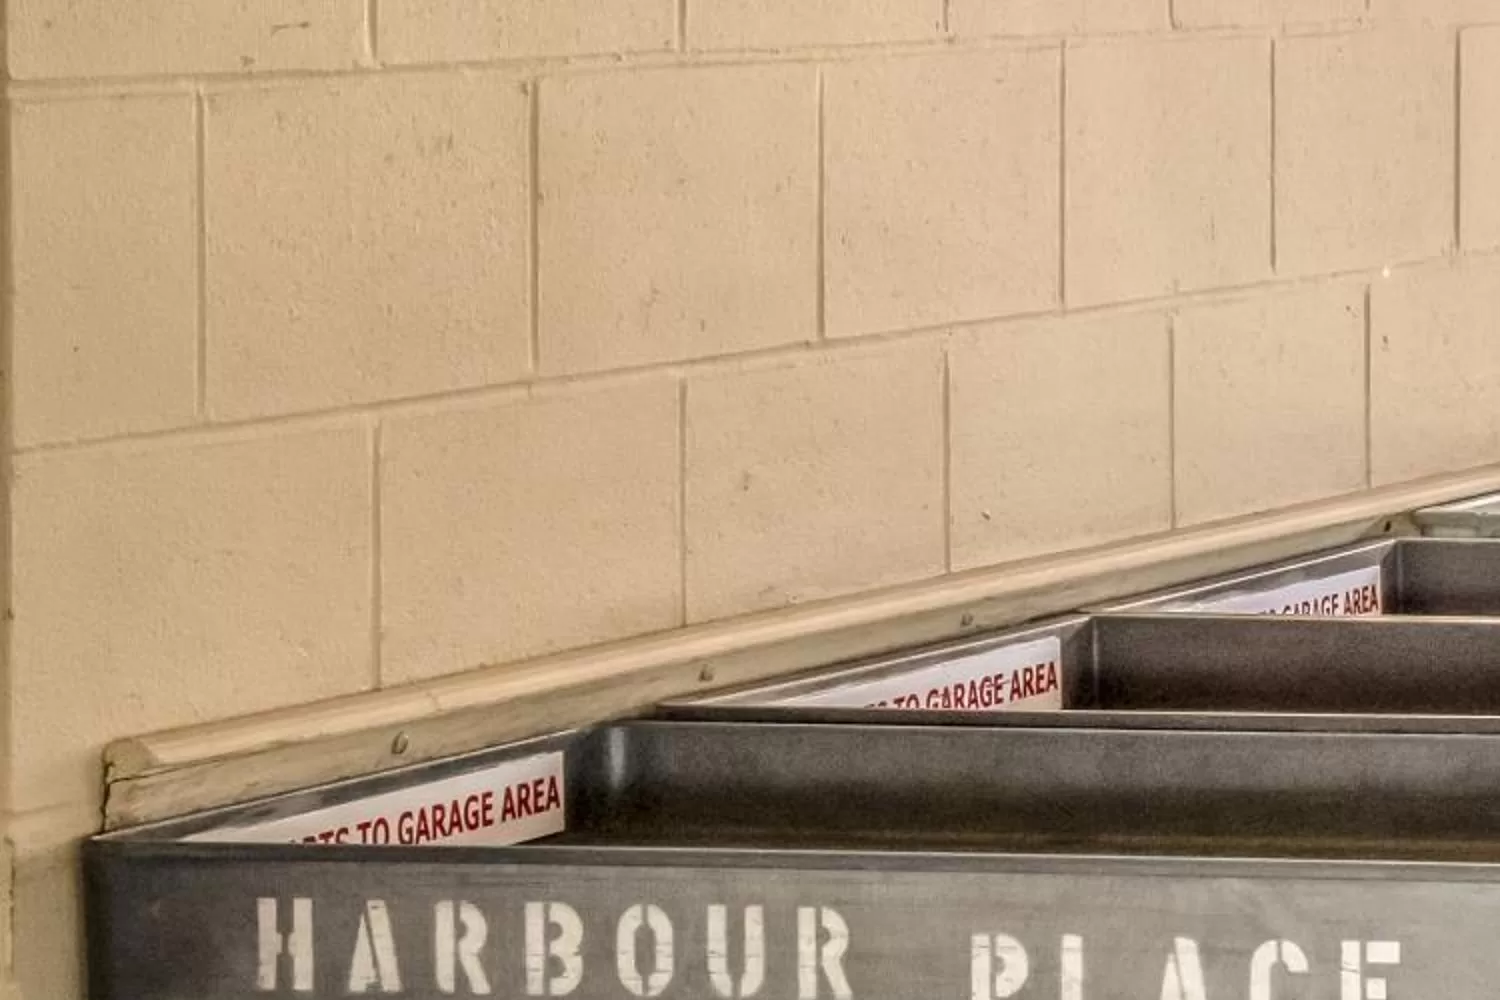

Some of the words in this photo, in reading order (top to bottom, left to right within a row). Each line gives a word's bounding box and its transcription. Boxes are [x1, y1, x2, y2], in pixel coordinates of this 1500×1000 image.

[1344, 584, 1378, 615] AREA
[926, 674, 1004, 709] GARAGE
[1010, 661, 1058, 702] AREA
[398, 792, 493, 844] GARAGE
[501, 776, 560, 822] AREA
